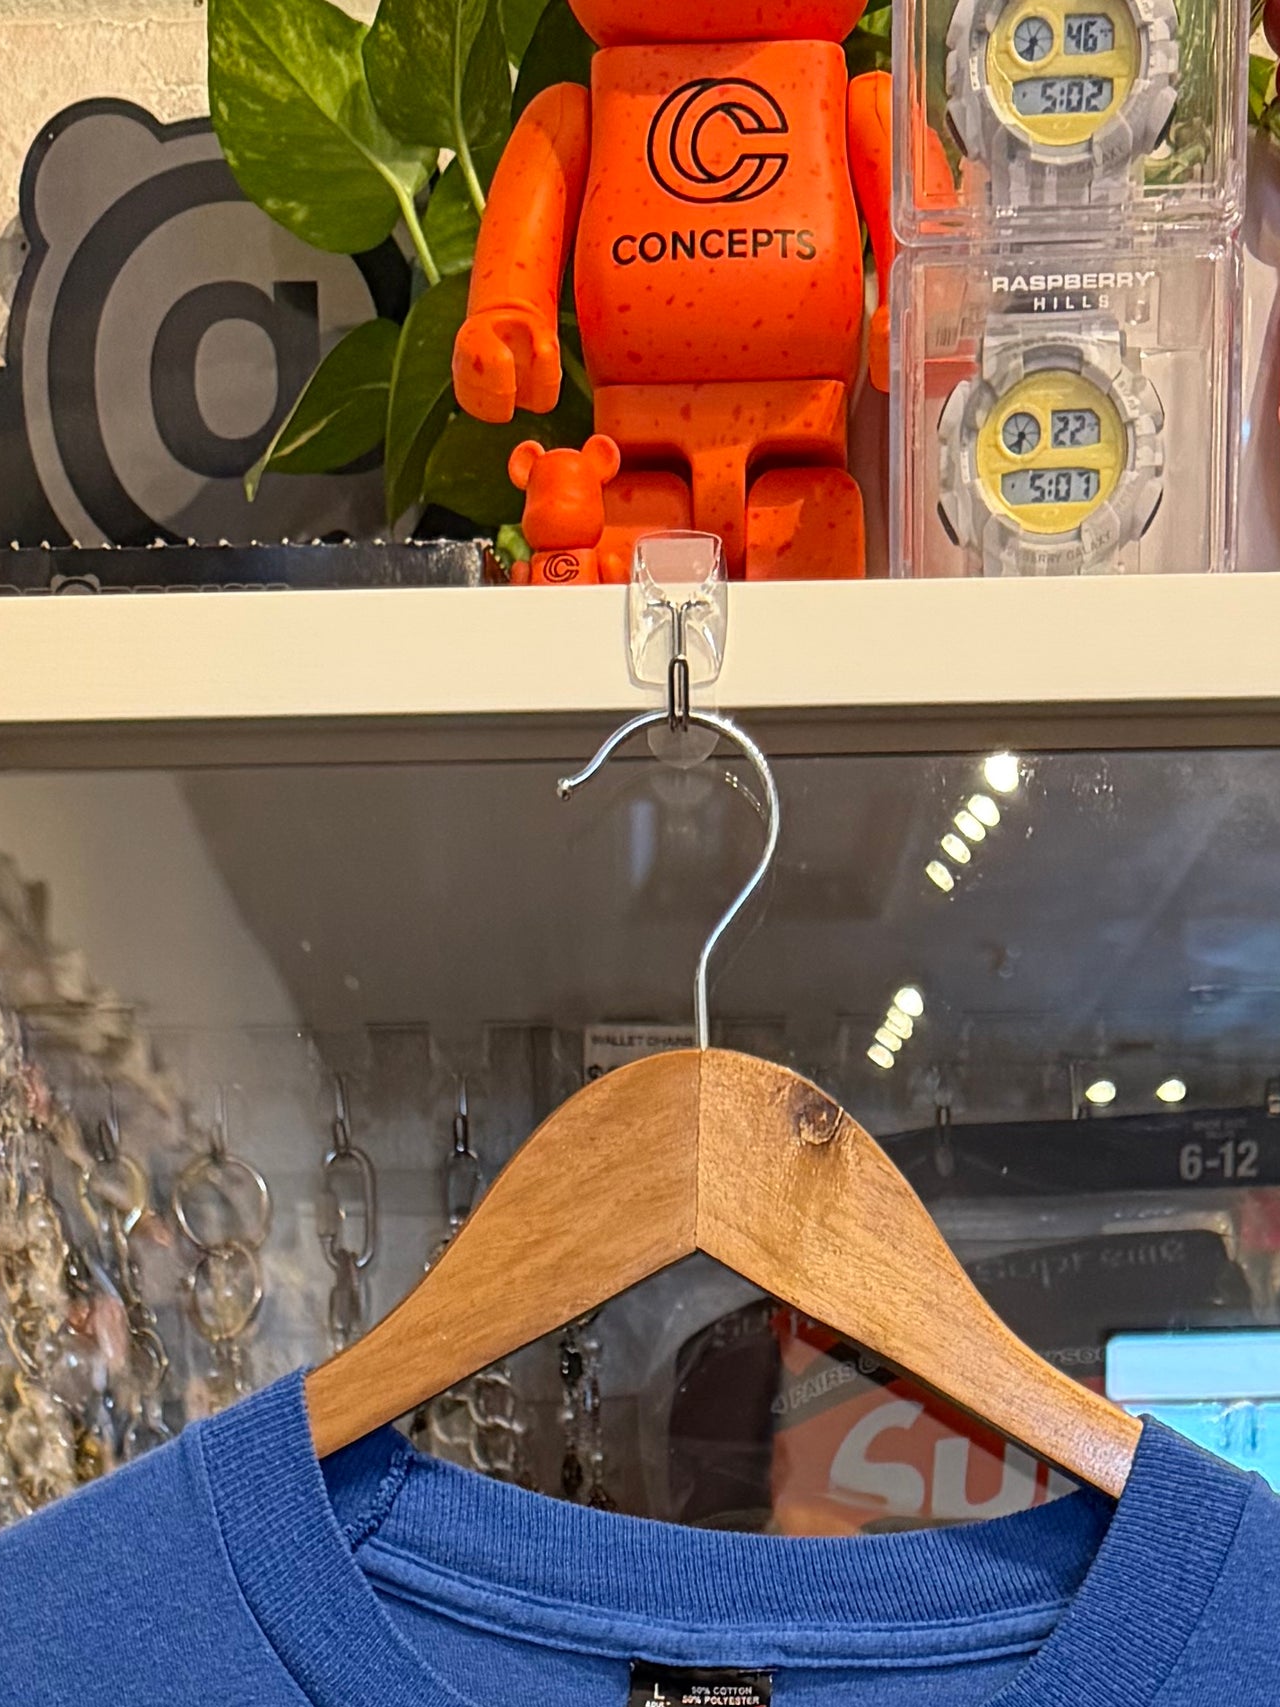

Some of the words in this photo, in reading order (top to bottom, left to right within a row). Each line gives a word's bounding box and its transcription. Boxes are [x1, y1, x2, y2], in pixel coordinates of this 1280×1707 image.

[1067, 20, 1099, 53] 46
[1041, 79, 1104, 113] 5:02
[611, 229, 817, 266] CONCEPTS
[992, 272, 1154, 292] RASPBERRY
[1033, 295, 1109, 311] HILLS
[1053, 415, 1087, 446] 22
[1179, 1139, 1259, 1182] 6-12
[654, 1682, 665, 1700] L
[704, 1695, 760, 1706] POLYESTER
[713, 1686, 753, 1696] COTTON
